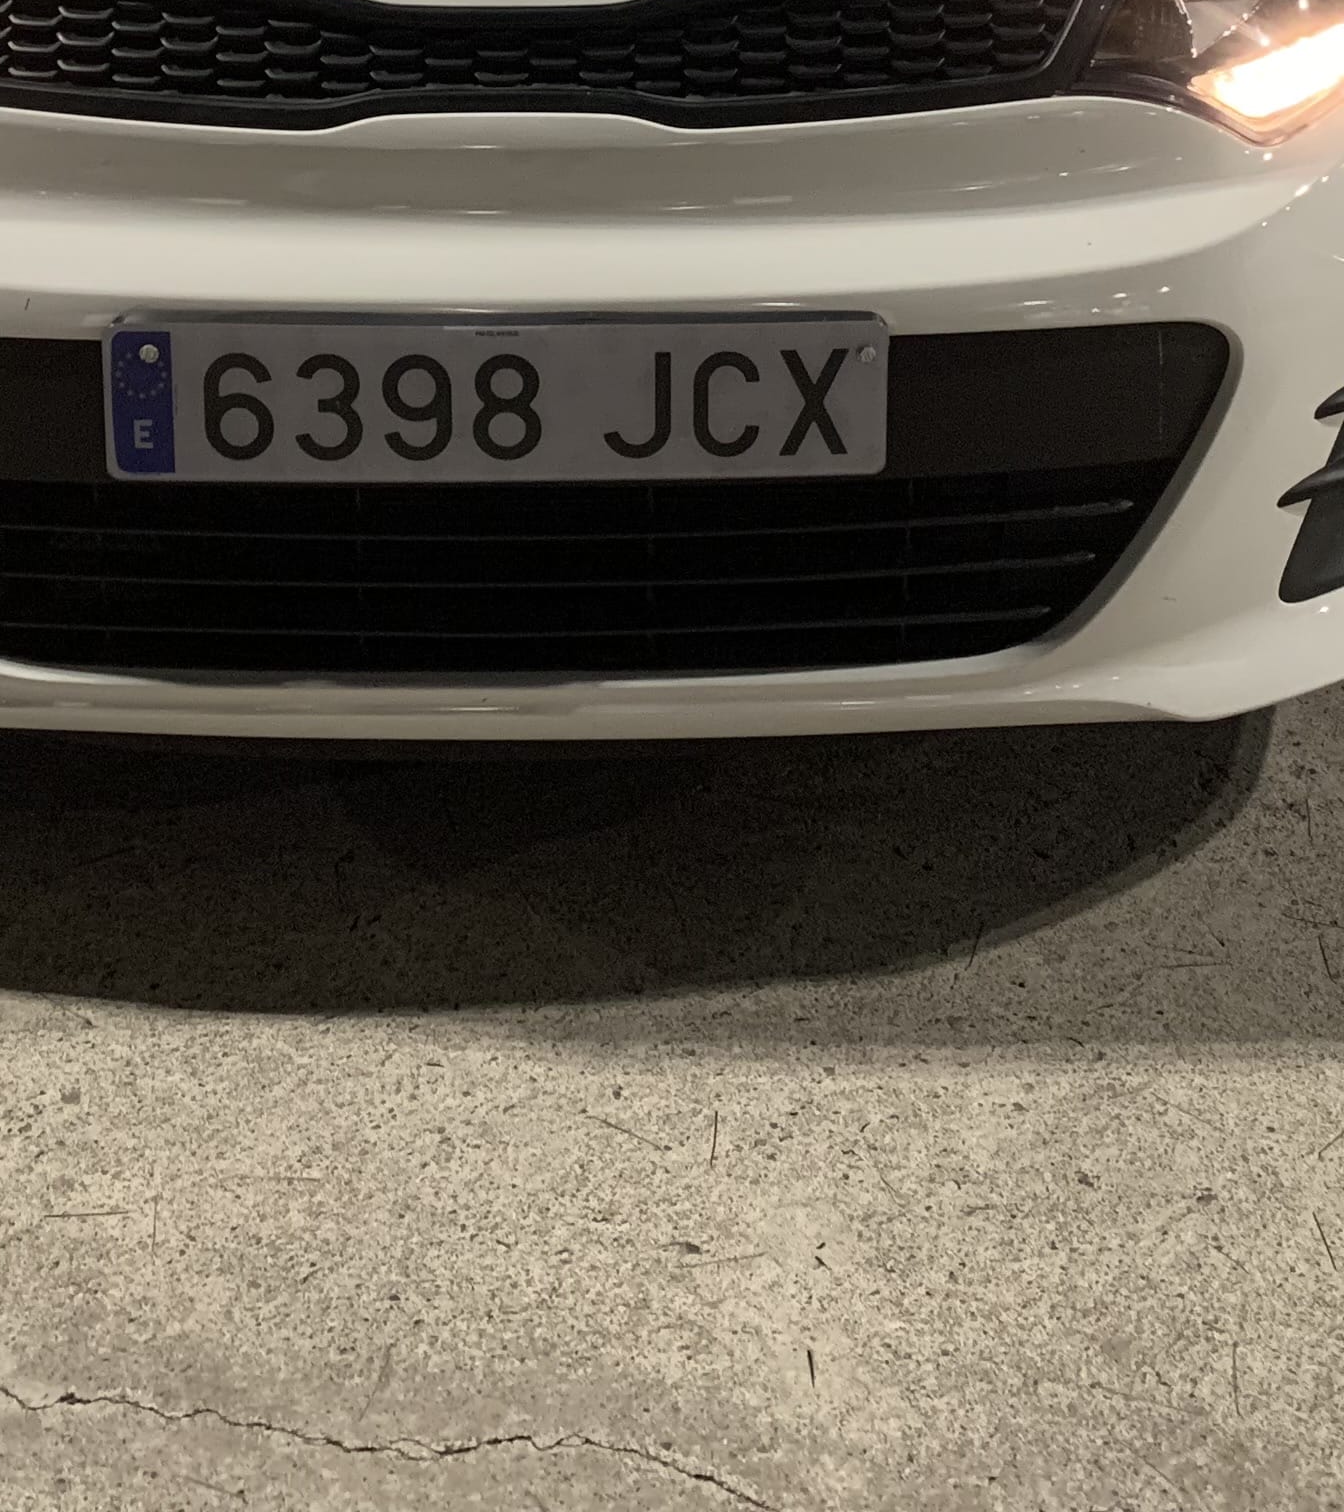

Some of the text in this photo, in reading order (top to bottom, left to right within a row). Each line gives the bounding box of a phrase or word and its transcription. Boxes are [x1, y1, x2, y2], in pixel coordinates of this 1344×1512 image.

[133, 347, 849, 462] E 6398 JCX
